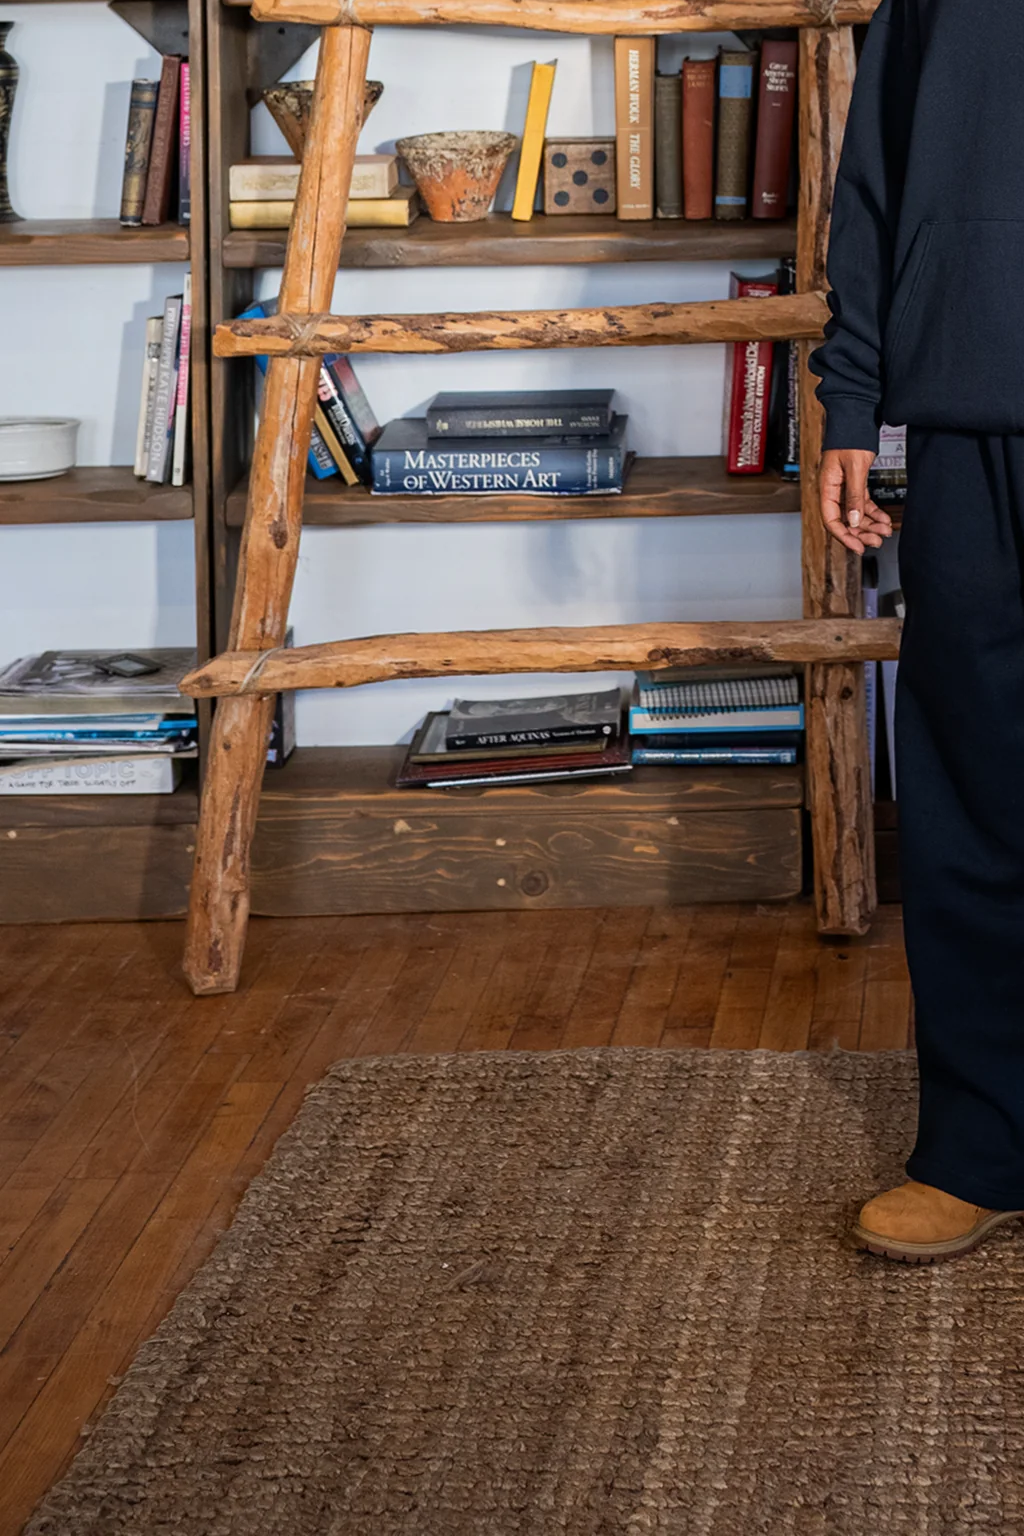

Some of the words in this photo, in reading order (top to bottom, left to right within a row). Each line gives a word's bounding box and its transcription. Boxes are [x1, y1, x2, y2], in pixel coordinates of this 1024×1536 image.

[629, 49, 640, 93] HERMAN
[762, 69, 795, 78] American
[768, 77, 788, 85] Short
[766, 84, 789, 92] Stories
[629, 133, 640, 154] THE
[630, 155, 641, 189] GLORY
[158, 370, 171, 405] KATE
[755, 365, 766, 398] EDITION
[516, 419, 544, 428] HORSE
[545, 418, 564, 427] THE
[753, 398, 764, 433] COLLEGE
[150, 408, 167, 462] HUDSON
[737, 410, 753, 468] Webster's
[403, 450, 540, 470] MASTERPIECES
[403, 475, 428, 490] OF
[428, 471, 518, 490] WESTERN
[522, 468, 562, 488] ART
[476, 735, 508, 745] AFTER
[510, 731, 551, 743] AQUINAS
[64, 760, 135, 779] TOPIC
